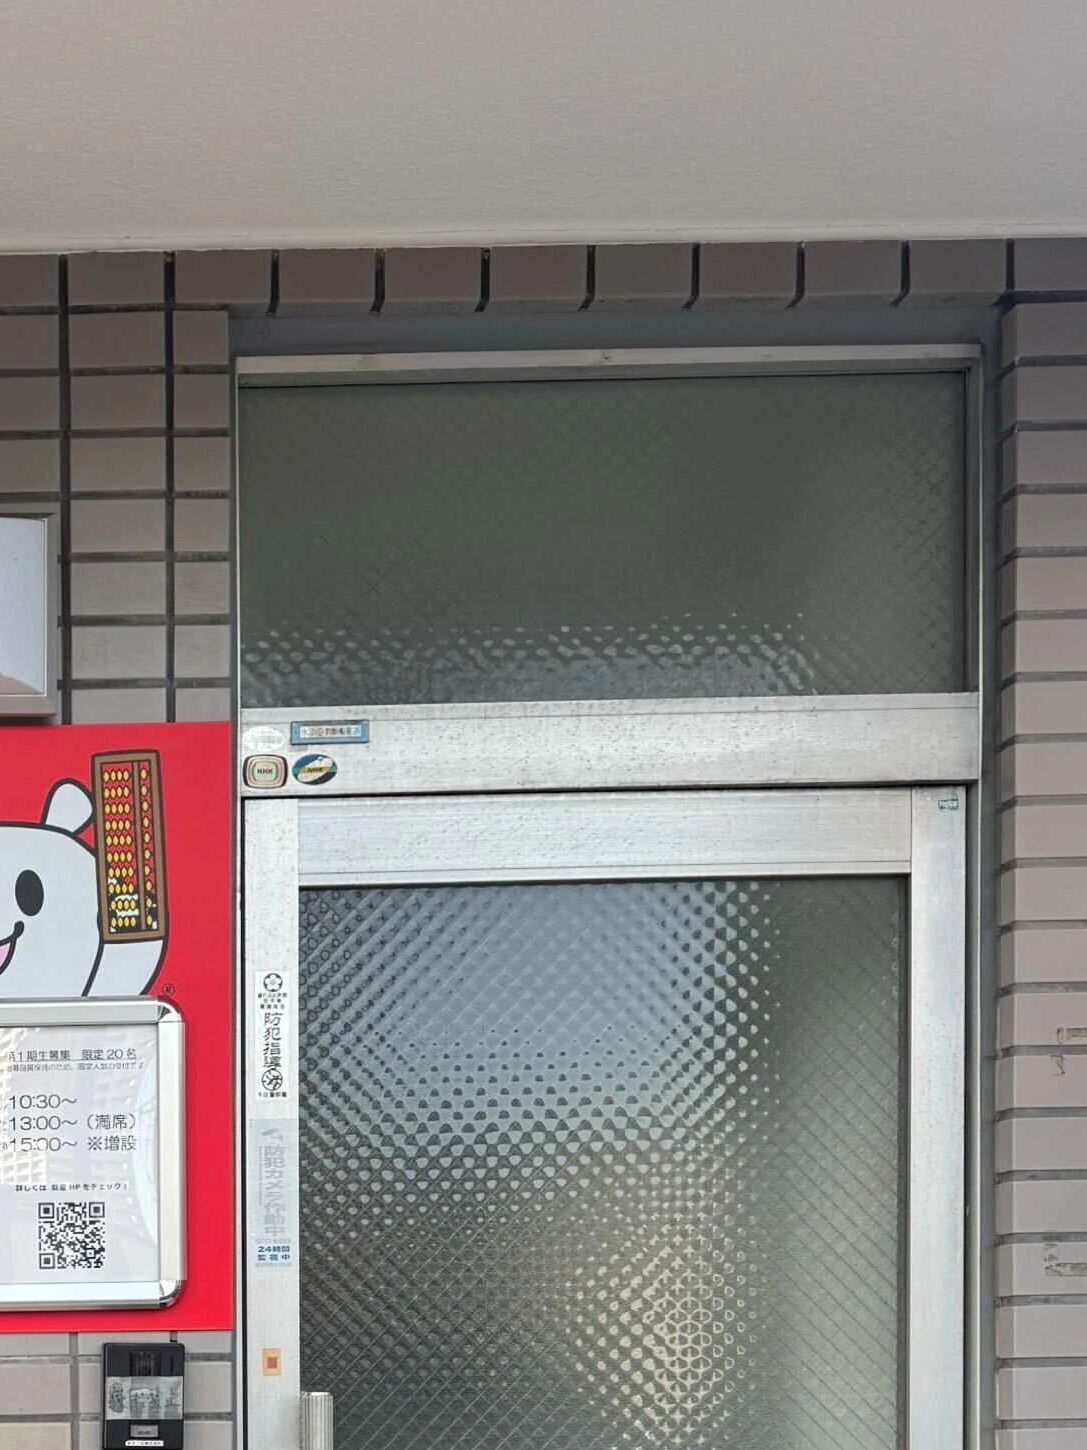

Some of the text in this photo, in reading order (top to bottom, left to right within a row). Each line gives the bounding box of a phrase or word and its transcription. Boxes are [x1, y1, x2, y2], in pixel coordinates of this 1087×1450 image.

[263, 1012, 283, 1068] 防犯指導
[263, 1145, 286, 1236] 防犯カメラ作動中
[257, 1245, 290, 1253] 24時間
